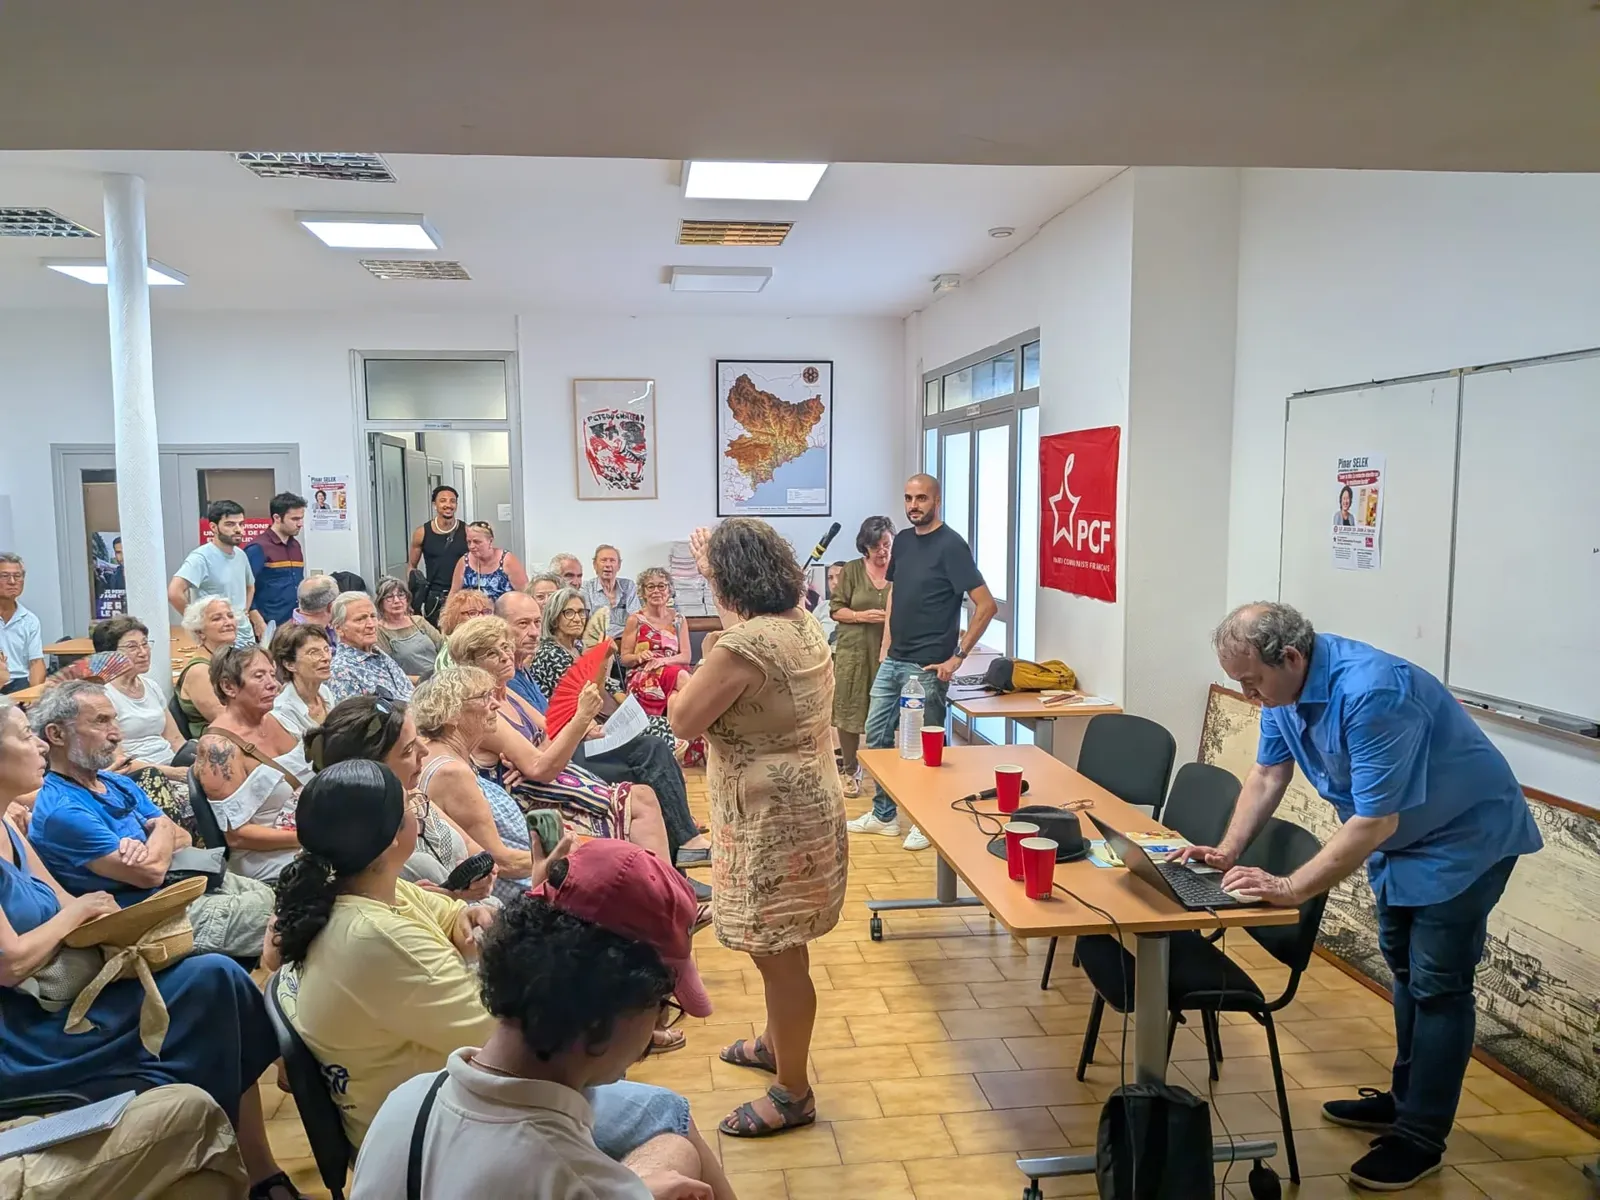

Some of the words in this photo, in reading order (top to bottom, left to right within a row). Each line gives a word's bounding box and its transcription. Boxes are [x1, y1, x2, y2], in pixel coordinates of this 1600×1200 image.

[1352, 457, 1368, 468] SELEK
[1077, 519, 1111, 554] PCF
[1064, 558, 1089, 568] COMMUNISTE
[100, 601, 114, 610] JE
